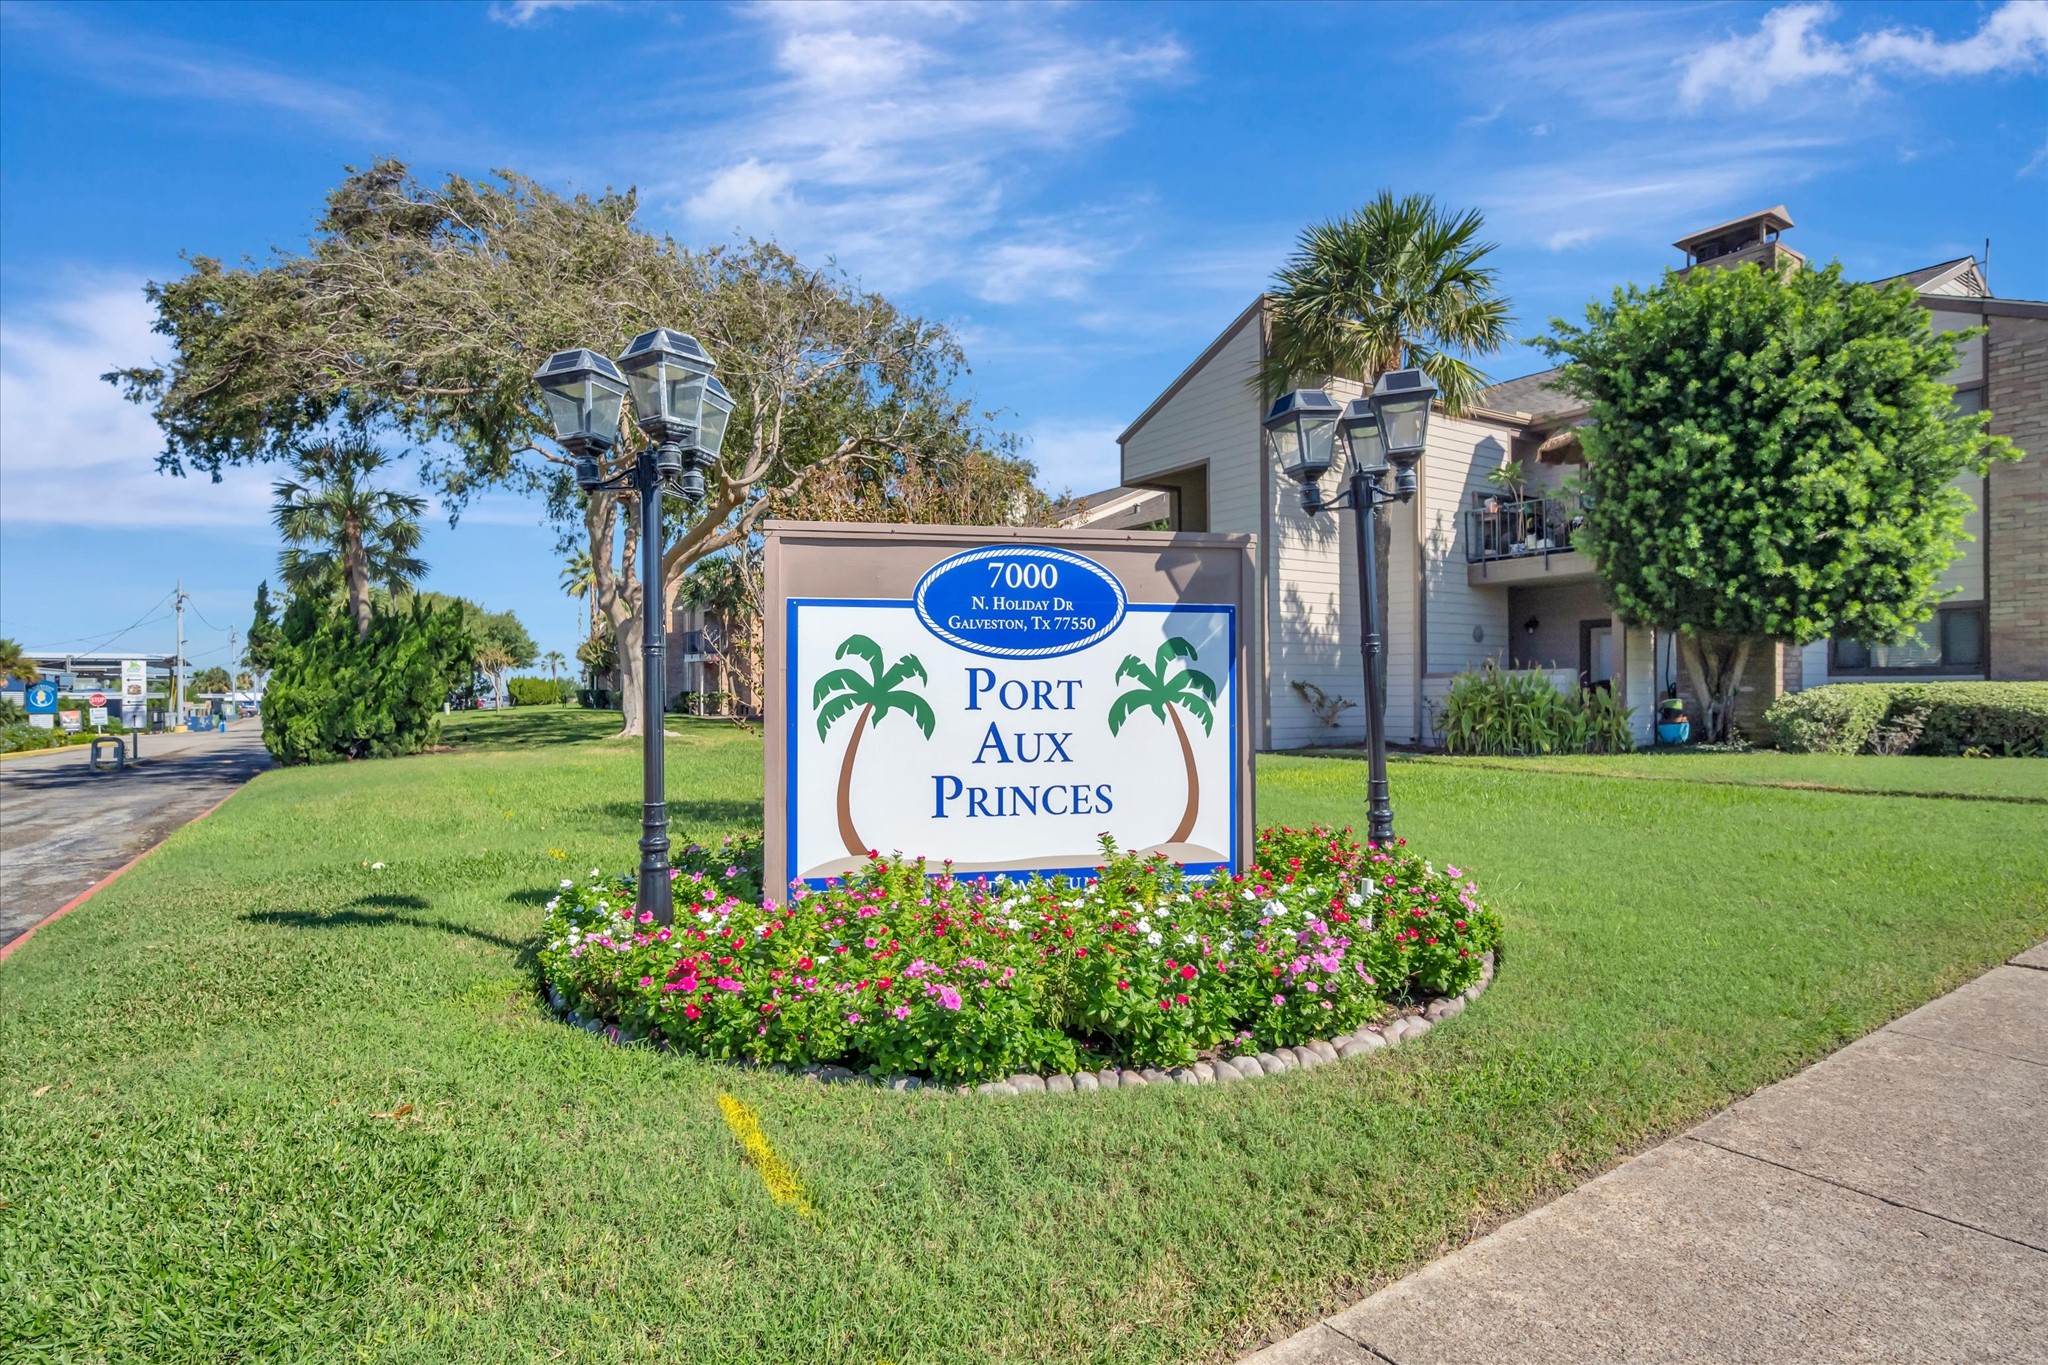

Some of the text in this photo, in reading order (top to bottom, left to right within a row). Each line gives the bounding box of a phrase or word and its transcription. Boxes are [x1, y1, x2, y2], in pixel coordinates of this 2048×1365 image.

[988, 563, 1057, 588] 7000
[972, 597, 1073, 610] N. HOLIDAY DR
[948, 616, 1095, 631] GALVESTON, TX 77550
[965, 668, 1082, 710] PORT
[972, 722, 1073, 763] AUX
[932, 776, 1112, 818] PRINCES
